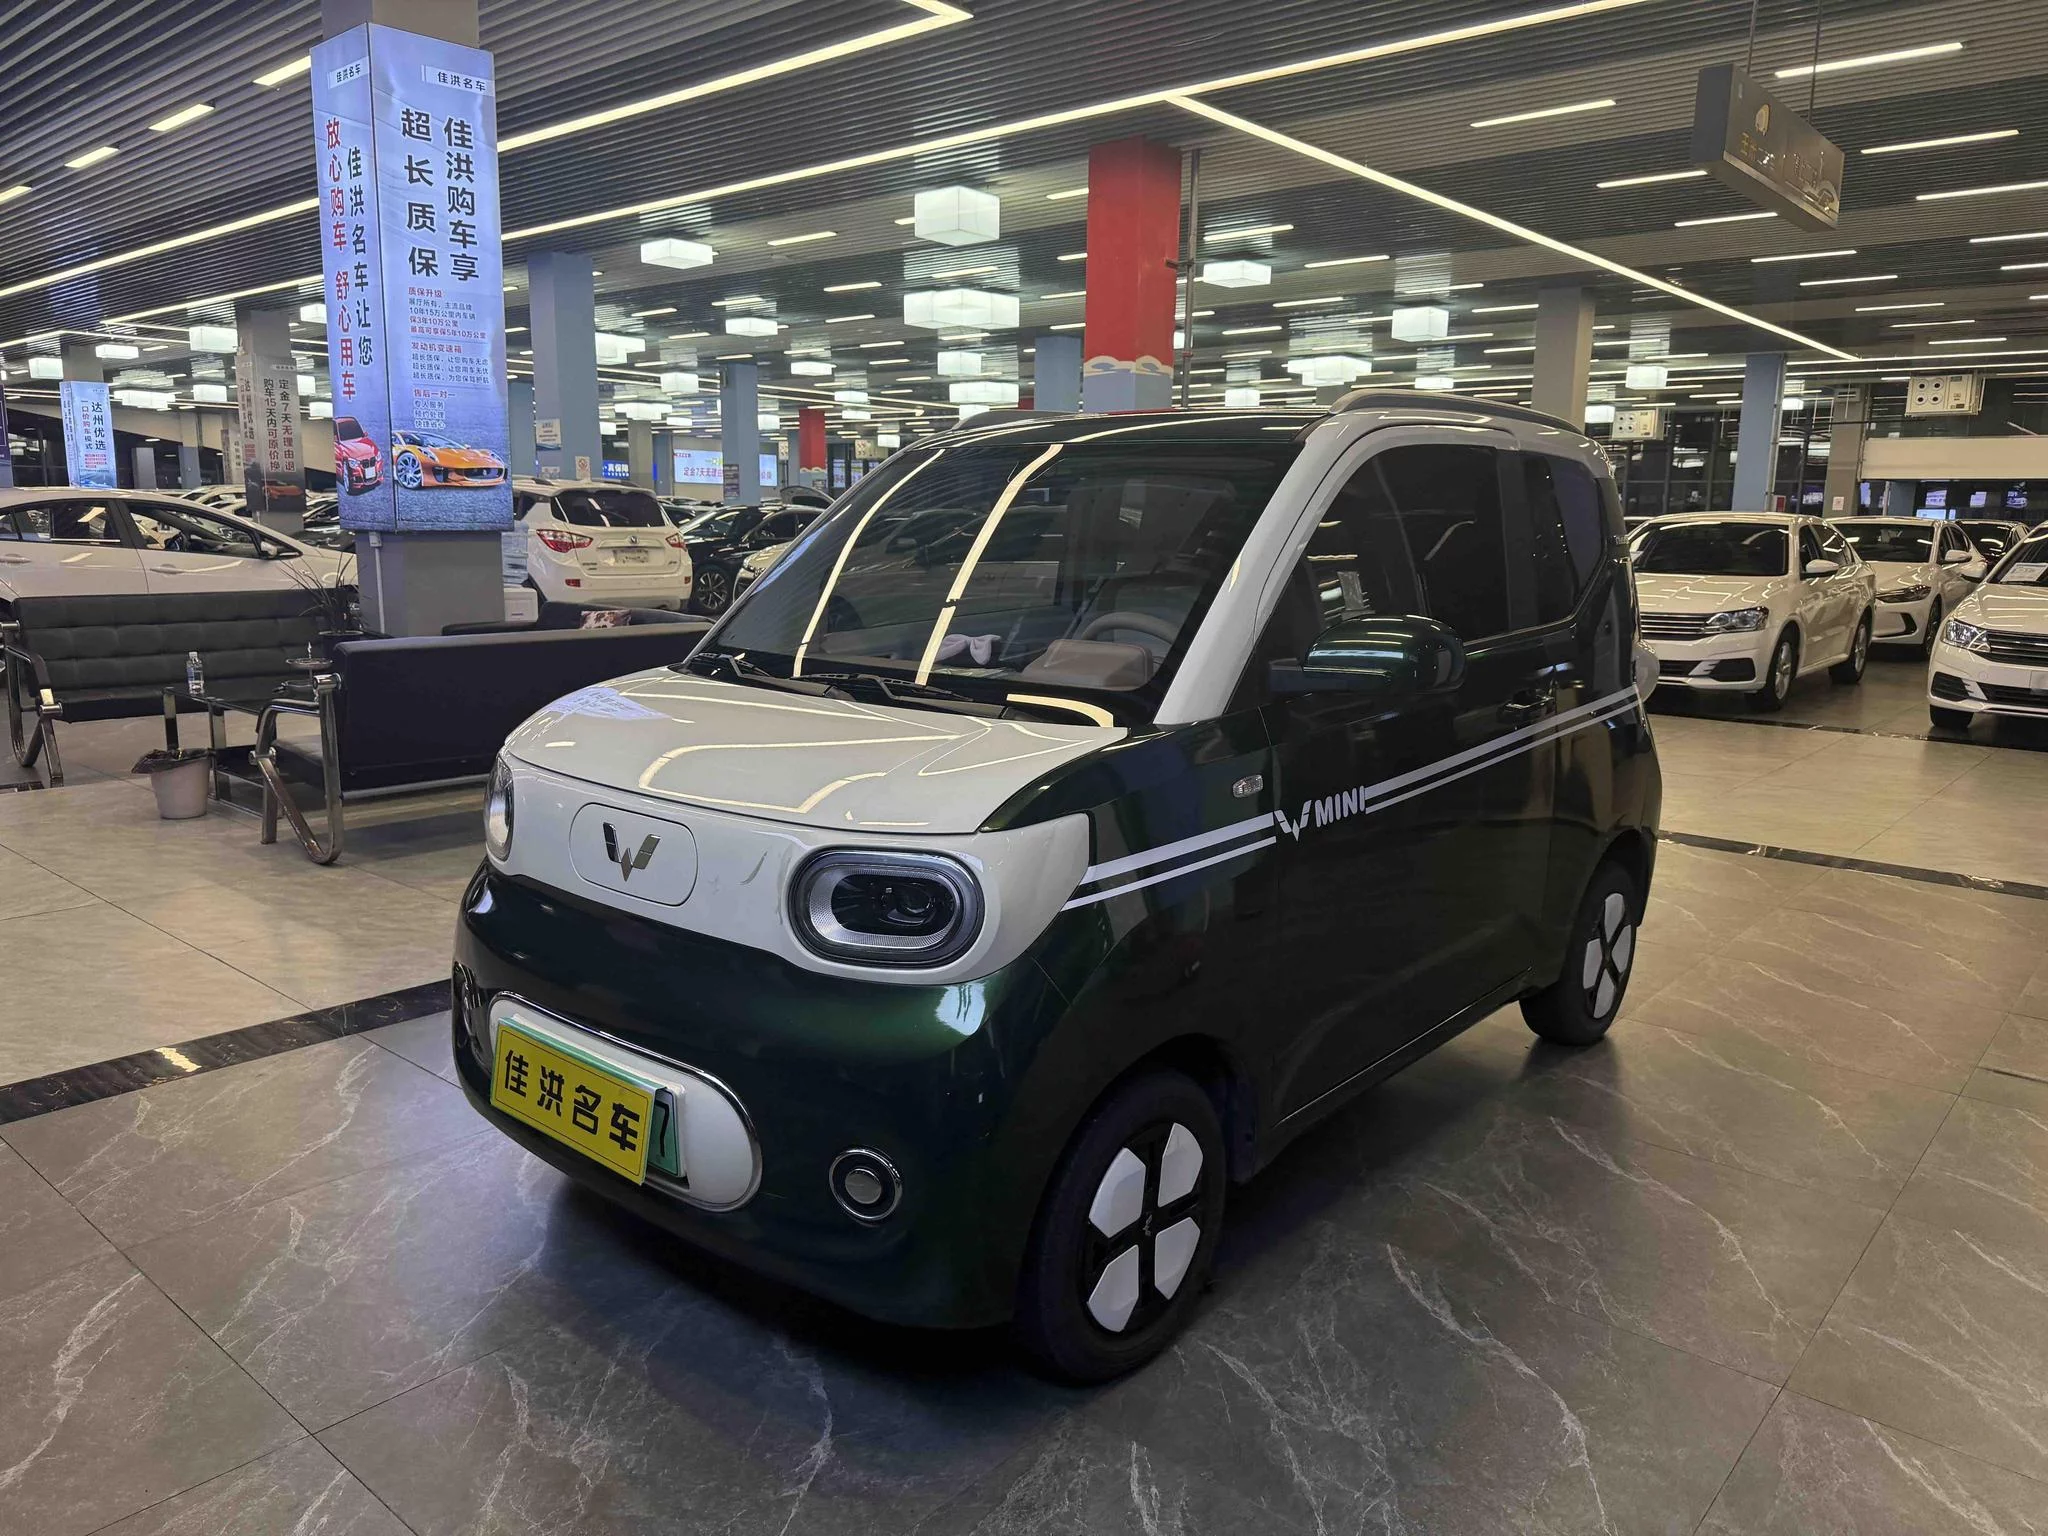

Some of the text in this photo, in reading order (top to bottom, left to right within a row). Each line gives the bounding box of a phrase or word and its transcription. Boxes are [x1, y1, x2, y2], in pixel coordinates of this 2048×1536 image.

[336, 63, 361, 83] 佳洪名车
[437, 71, 487, 92] 佳洪名车
[326, 117, 347, 251] 放心购车
[401, 108, 439, 277] 超长质保
[444, 117, 480, 281] 佳洪购车享
[347, 146, 373, 366] 佳洪名车让您
[91, 401, 107, 450] 达州优选
[1315, 785, 1366, 828] MINI
[504, 1049, 641, 1152] 佳洪名车
